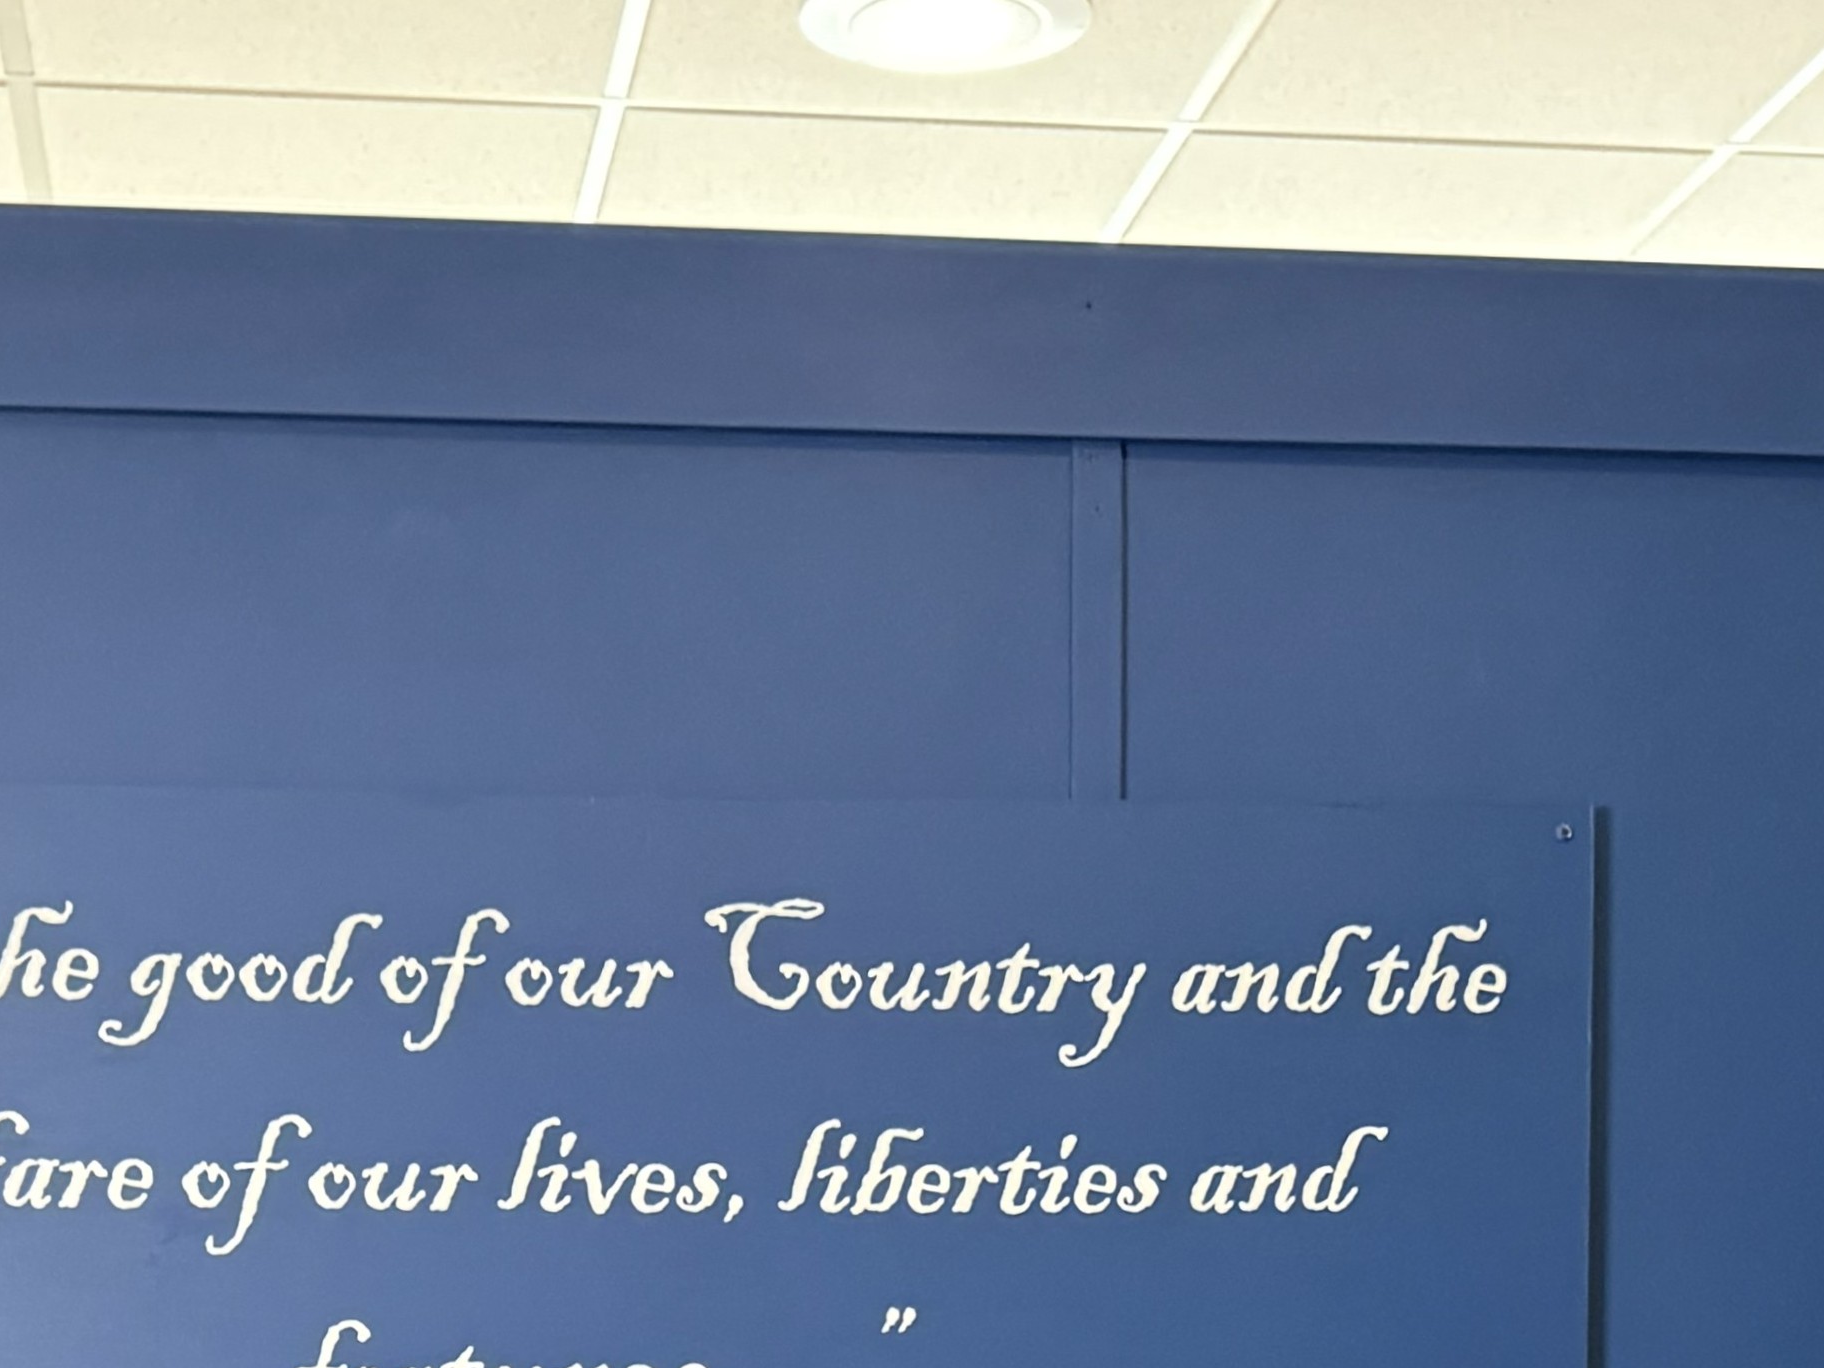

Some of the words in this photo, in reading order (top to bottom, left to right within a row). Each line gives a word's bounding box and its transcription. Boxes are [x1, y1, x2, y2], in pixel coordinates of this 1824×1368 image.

[98, 913, 383, 1046] good
[380, 908, 510, 1052] of
[505, 957, 674, 1008] our
[704, 898, 1147, 1067] Country
[1172, 925, 1372, 1014] and
[1367, 918, 1507, 1015] the
[181, 1114, 313, 1256] of
[308, 1162, 479, 1212] our
[497, 1116, 744, 1223] lives,
[777, 1118, 1167, 1215] liberties
[1190, 1126, 1389, 1214] and
